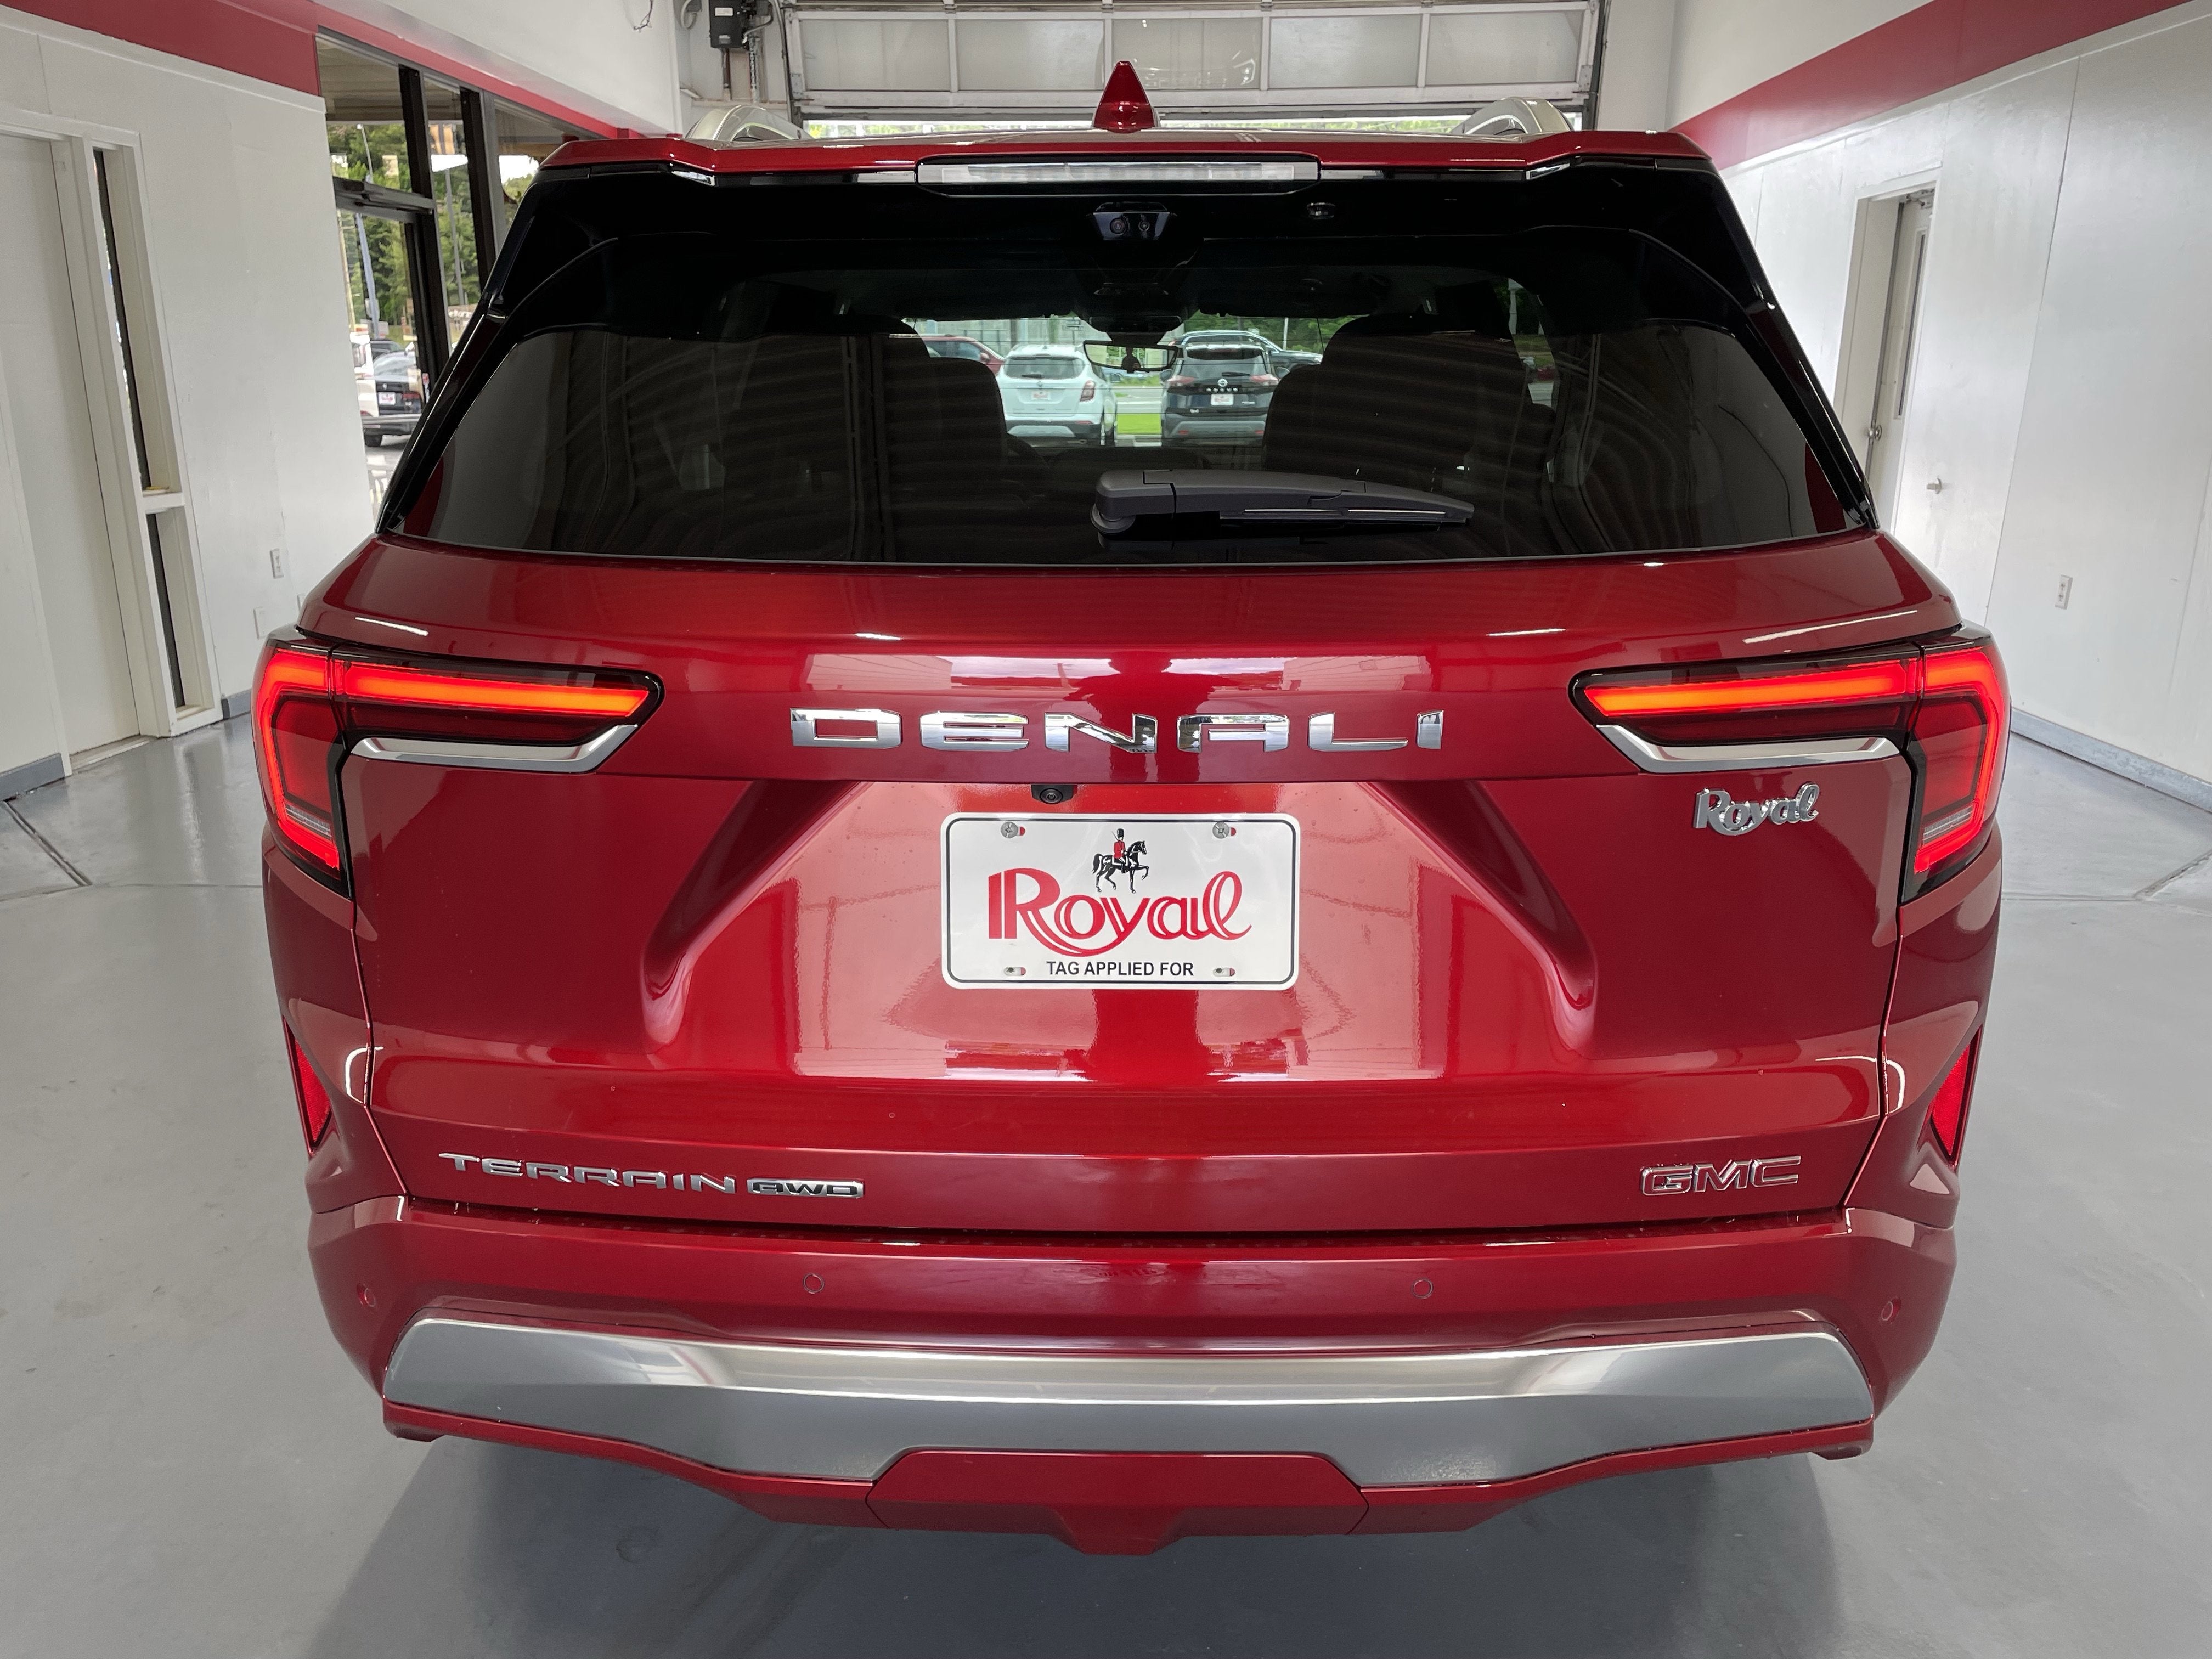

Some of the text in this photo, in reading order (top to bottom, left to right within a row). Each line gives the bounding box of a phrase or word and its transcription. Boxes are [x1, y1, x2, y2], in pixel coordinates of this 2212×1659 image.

[791, 707, 1444, 754] DENALI
[1693, 781, 1819, 836] Royal
[988, 867, 1252, 957] Royal
[1046, 961, 1194, 976] TAG APPLIED FOR
[439, 1153, 861, 1198] TERRAIN AWD
[1641, 1155, 1801, 1195] GMC
